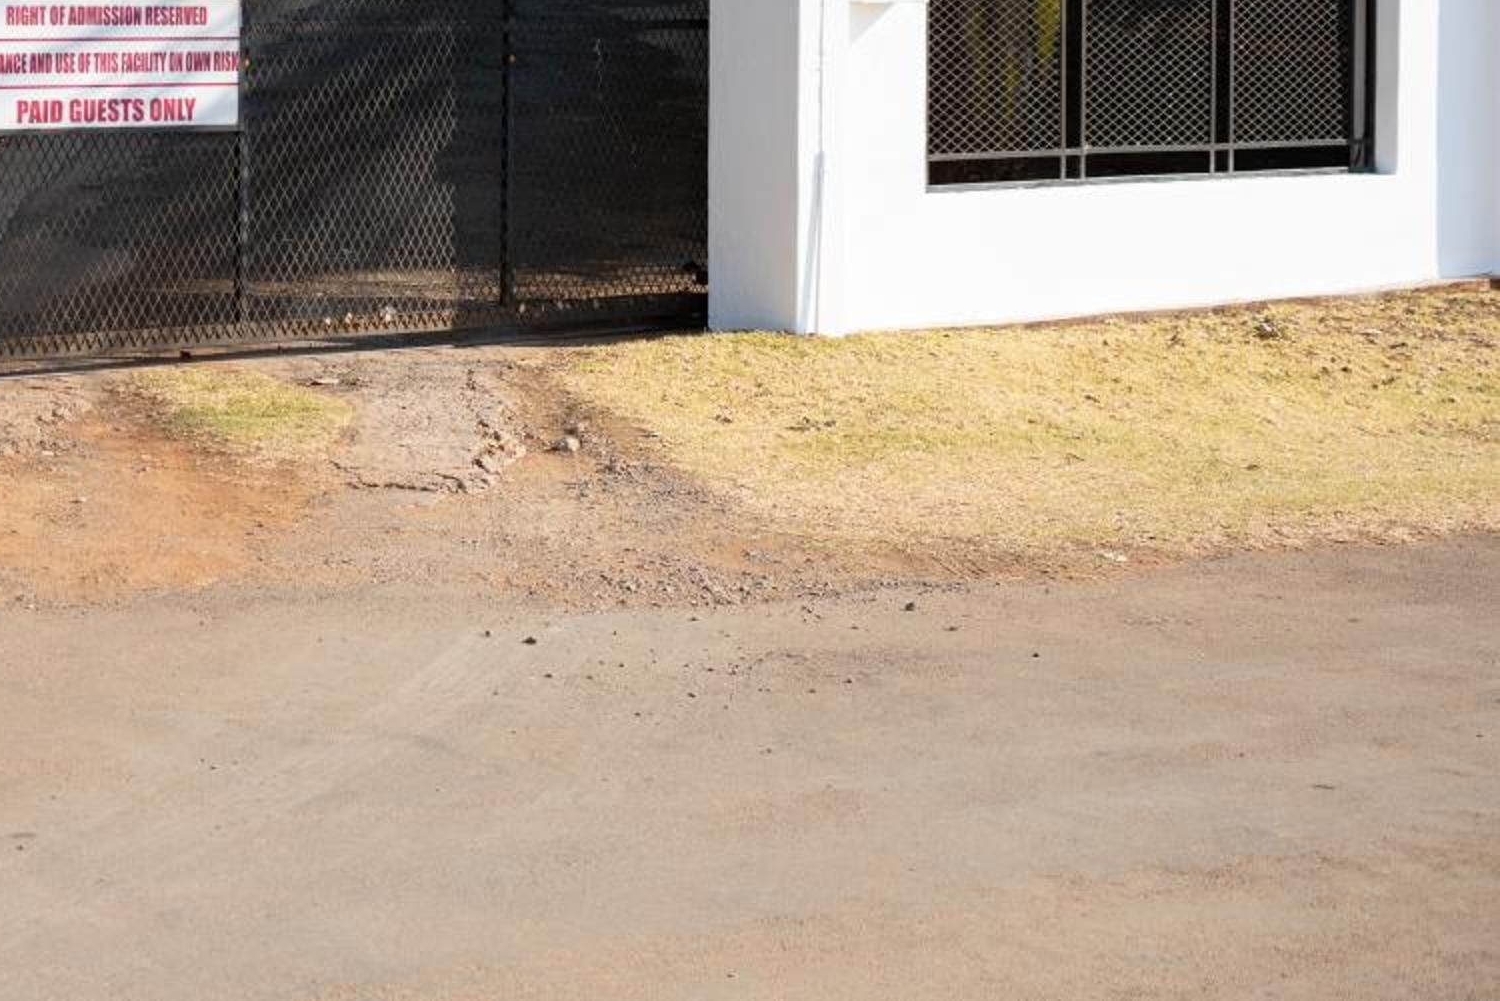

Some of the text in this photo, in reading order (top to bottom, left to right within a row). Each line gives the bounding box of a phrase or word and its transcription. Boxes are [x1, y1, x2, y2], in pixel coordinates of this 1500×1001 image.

[6, 5, 208, 26] RIGHT OF ADMISSION RESERVED
[29, 53, 52, 74] AND
[55, 52, 76, 74] USE
[78, 52, 92, 73] OF
[94, 52, 119, 73] THIS
[121, 51, 166, 73] FACILITY
[169, 51, 183, 72] ON
[185, 51, 211, 72] OWN
[213, 50, 239, 72] RISK
[17, 97, 197, 124] PAID GUESTS ONLY
